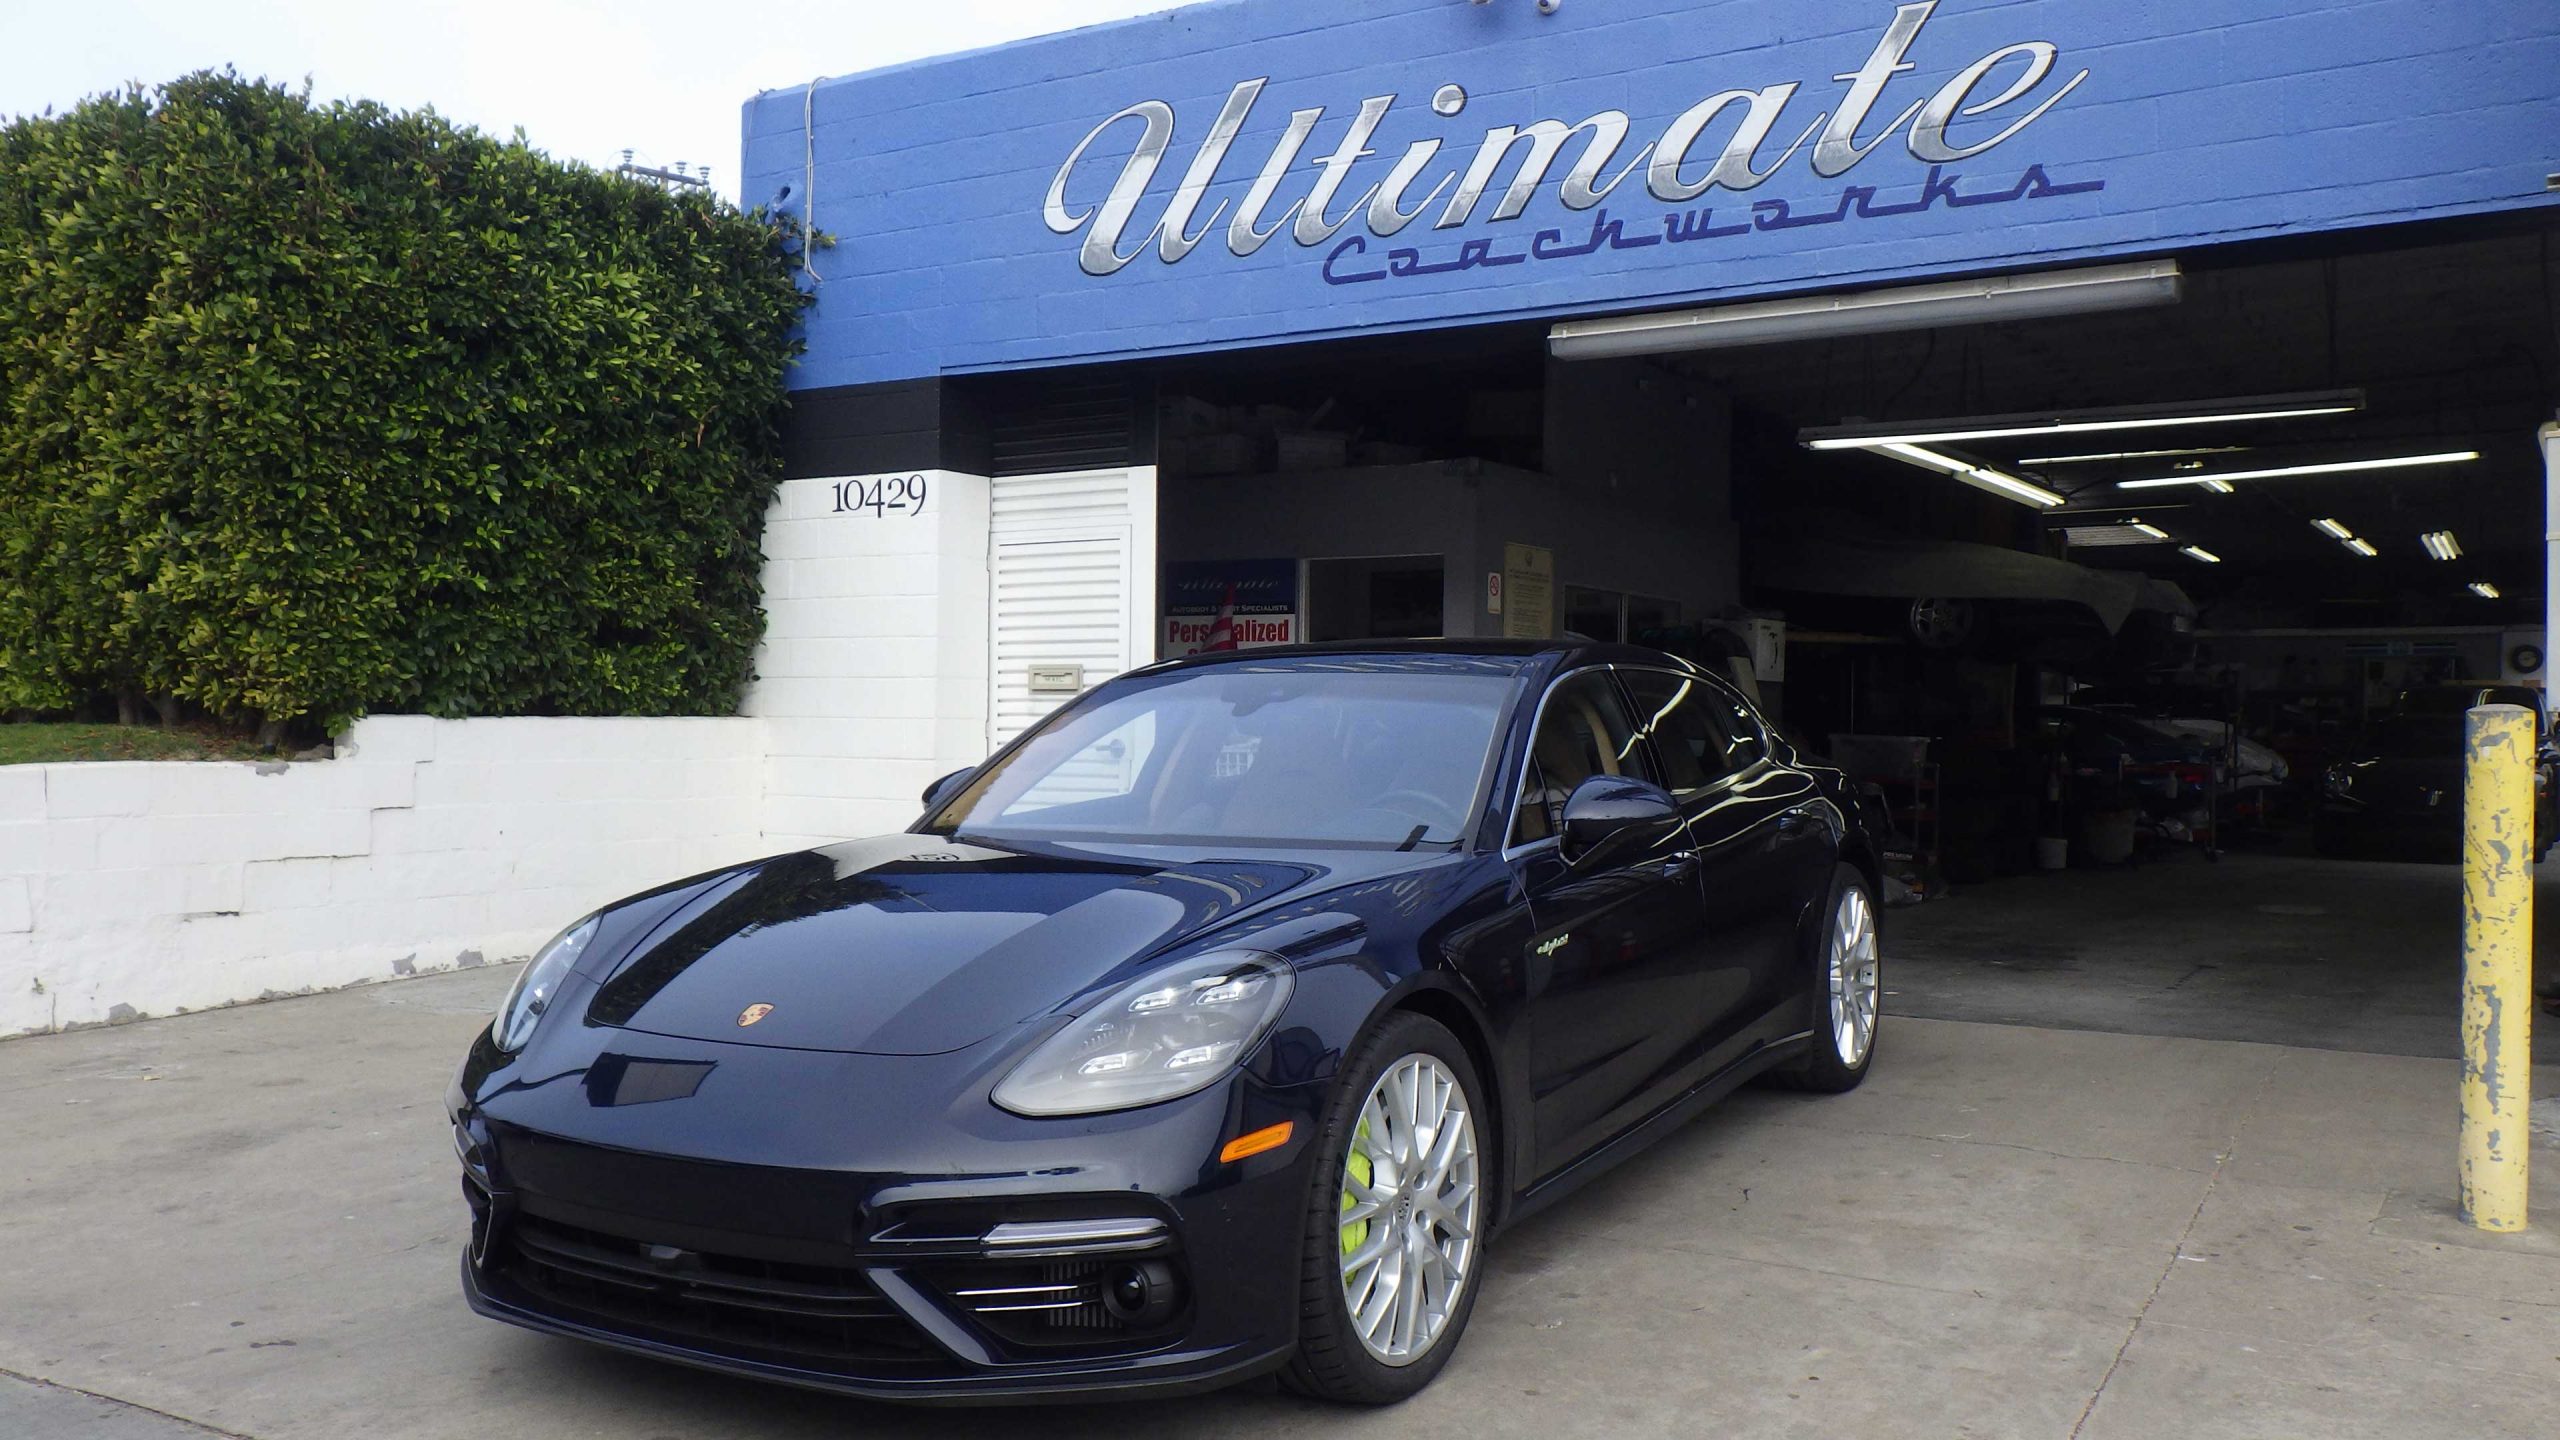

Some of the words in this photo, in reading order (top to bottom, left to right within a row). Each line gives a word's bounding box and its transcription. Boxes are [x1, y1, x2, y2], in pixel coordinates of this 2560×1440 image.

[1042, 0, 2089, 277] Ultimate
[1322, 162, 2105, 286] Coachworks
[832, 474, 927, 518] 10429
[1169, 619, 1289, 643] Persalized
